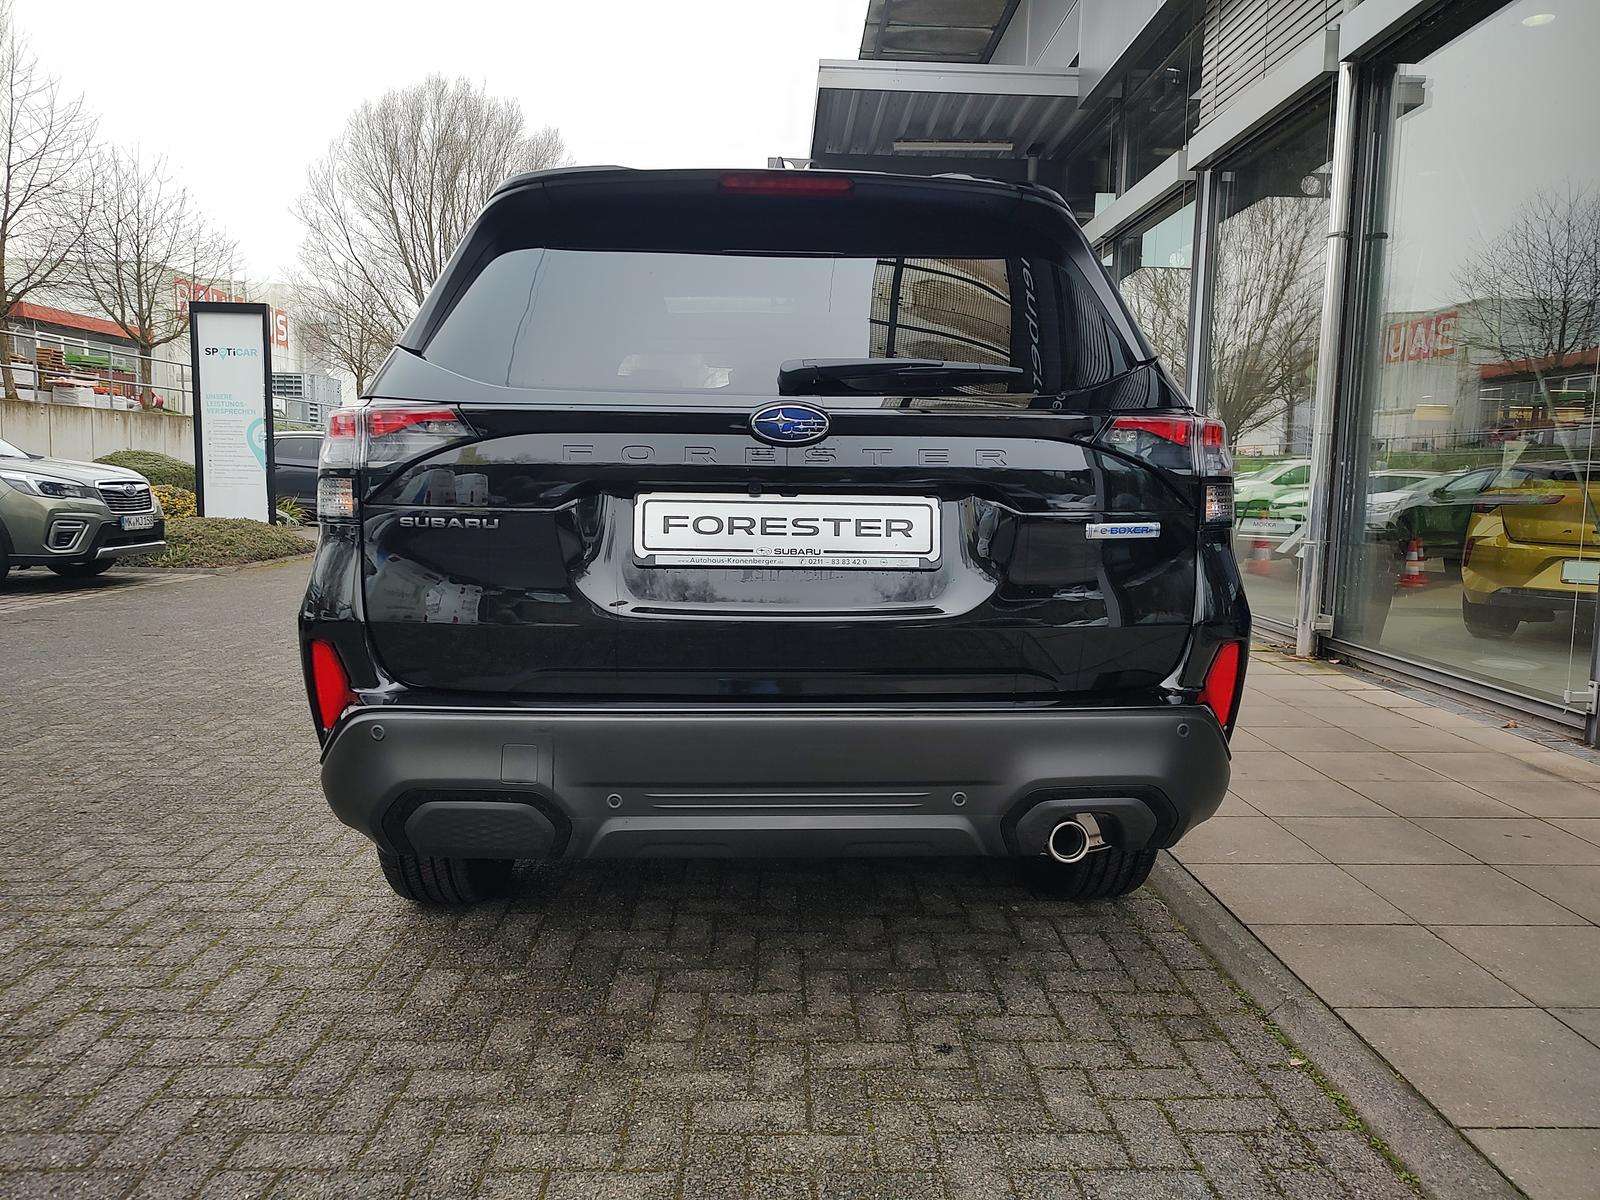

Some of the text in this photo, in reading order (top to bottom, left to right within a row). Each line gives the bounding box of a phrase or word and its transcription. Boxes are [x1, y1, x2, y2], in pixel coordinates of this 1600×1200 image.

[563, 444, 1008, 466] FORESTER
[400, 516, 499, 529] SUBARU
[663, 515, 913, 538] FORESTER
